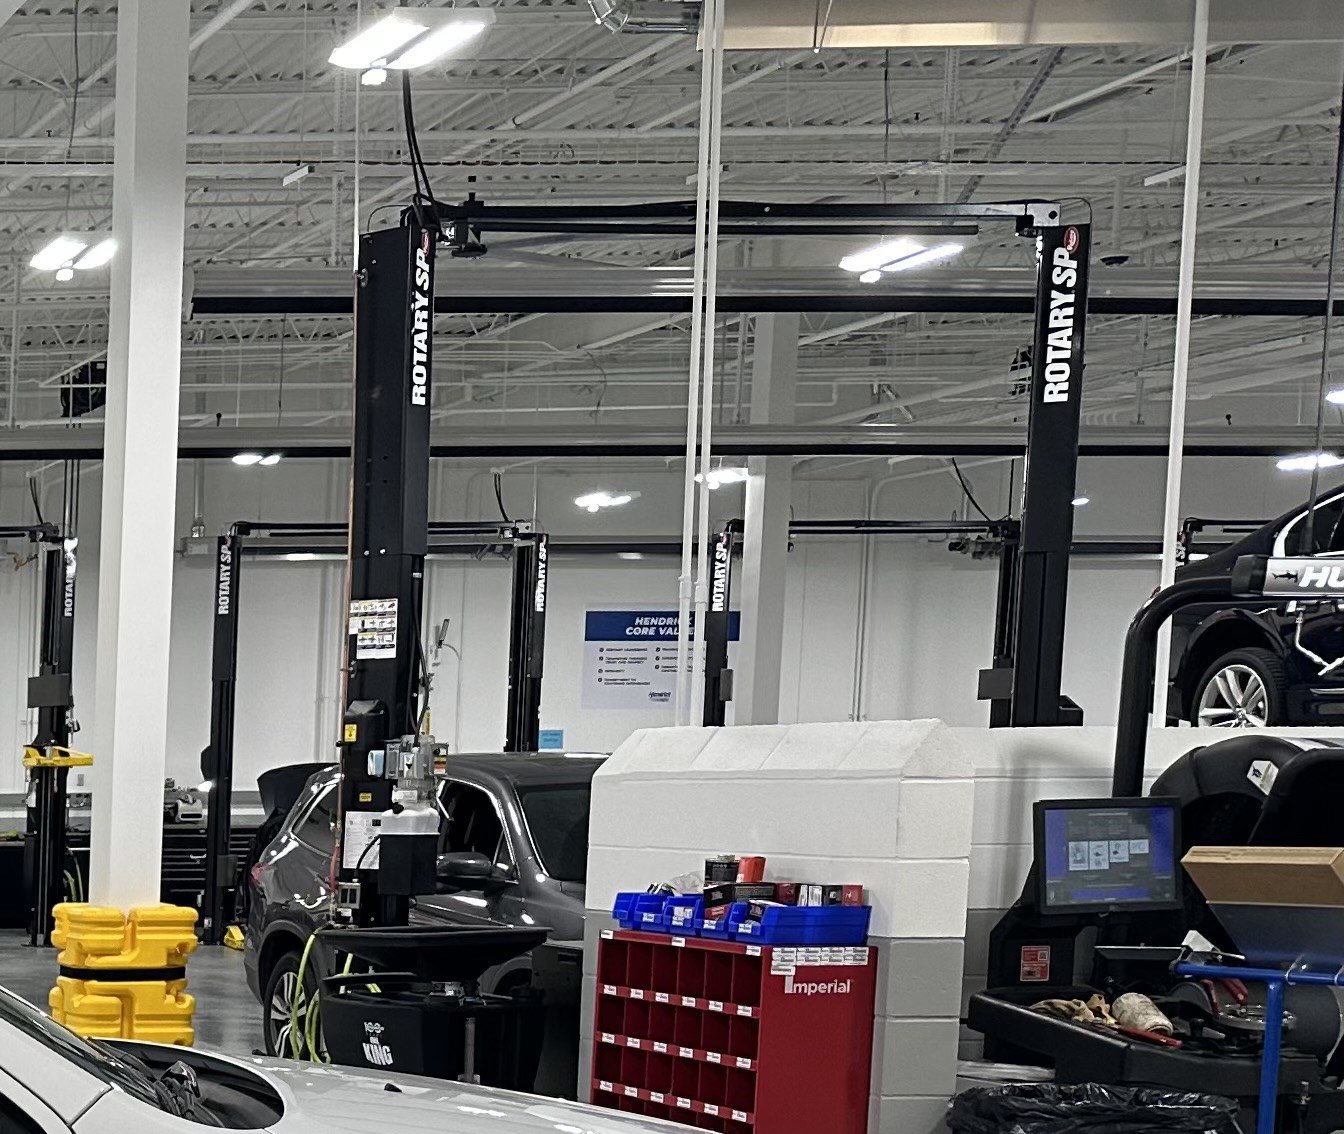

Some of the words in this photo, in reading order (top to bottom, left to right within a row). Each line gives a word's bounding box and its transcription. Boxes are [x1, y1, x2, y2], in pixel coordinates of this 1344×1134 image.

[415, 247, 430, 291] SP
[1051, 246, 1078, 288] SP
[412, 290, 429, 406] ROTARY
[1043, 290, 1076, 403] ROTARY
[220, 545, 232, 563] SP
[715, 542, 727, 561] SP
[64, 574, 73, 617] ROTA
[217, 563, 231, 615] ROTARY
[535, 560, 546, 612] ROTARY
[712, 560, 726, 612] ROTARY
[625, 626, 657, 636] CORE
[658, 626, 695, 636] VALE
[634, 616, 693, 626] HENDRIK
[784, 974, 851, 996] Imperial
